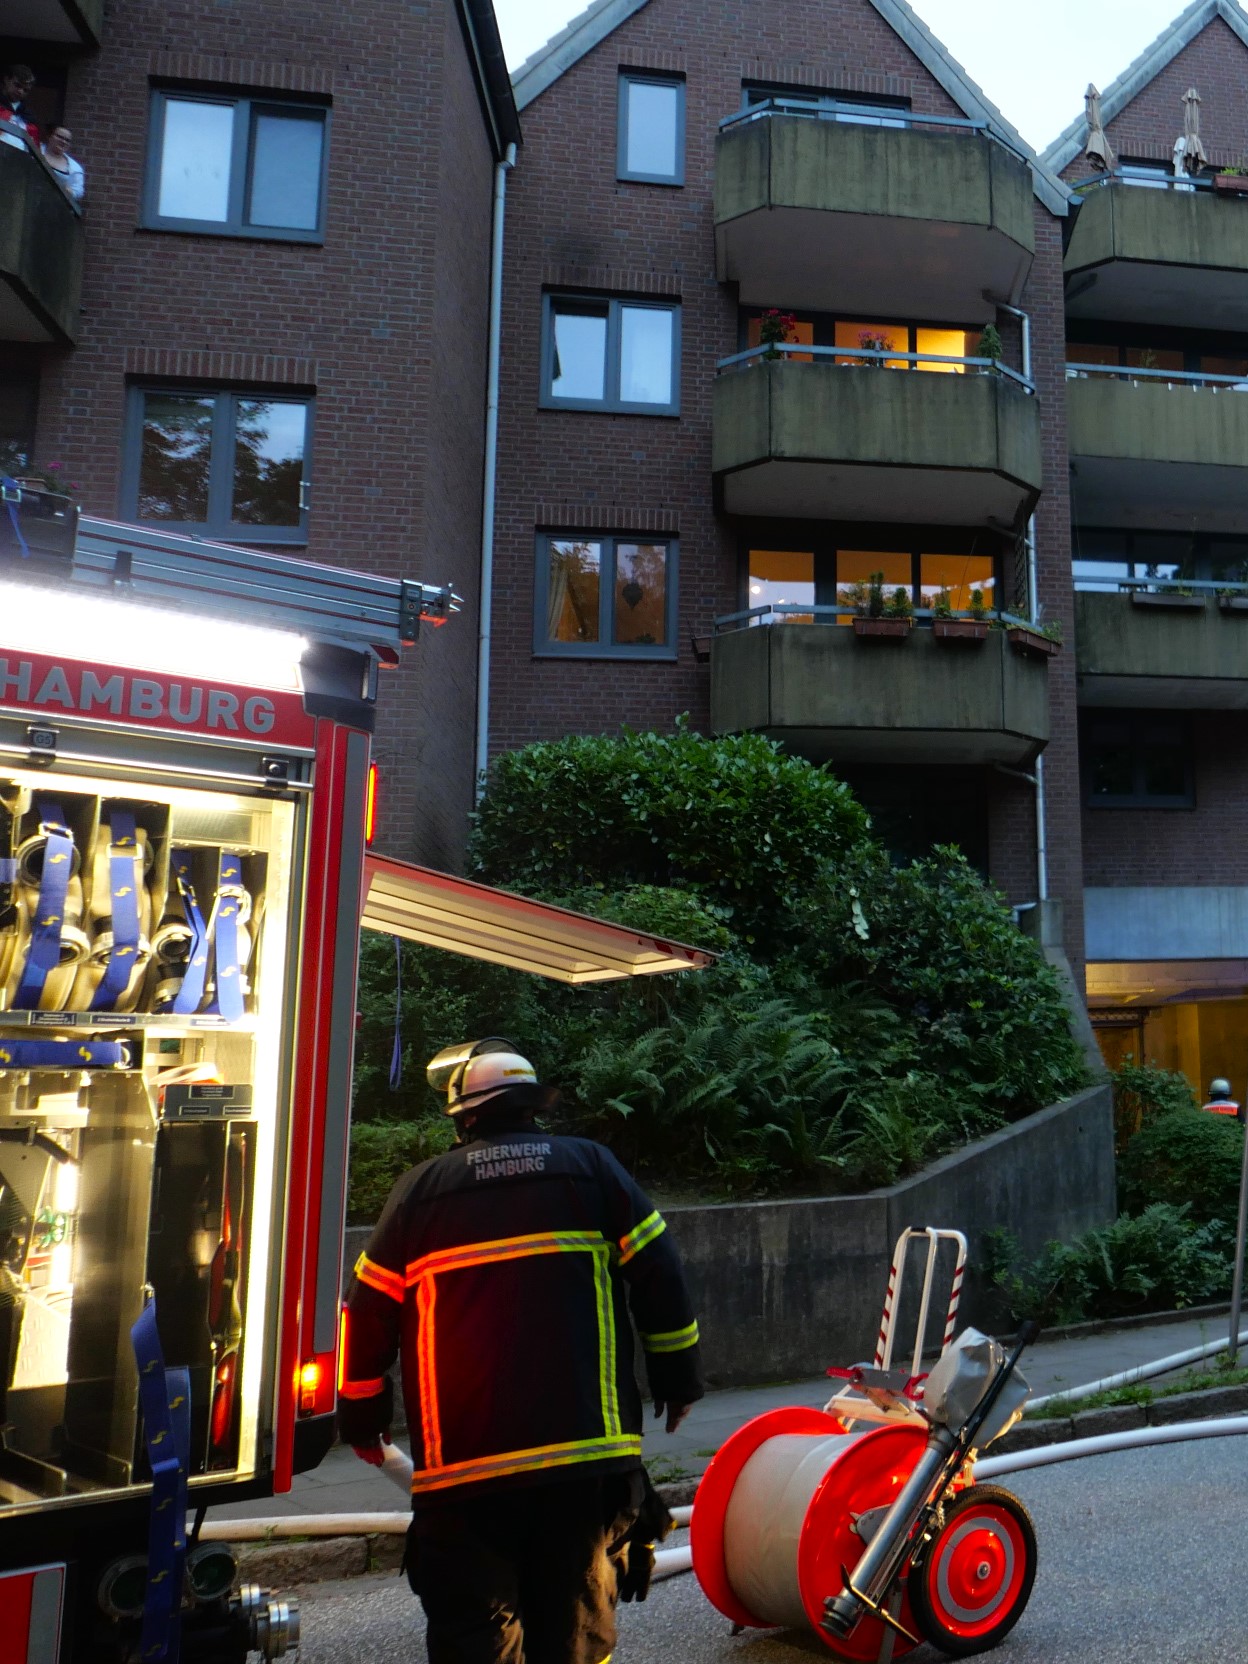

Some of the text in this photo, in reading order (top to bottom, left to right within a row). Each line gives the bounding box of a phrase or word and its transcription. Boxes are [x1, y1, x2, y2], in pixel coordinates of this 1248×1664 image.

[0, 658, 275, 734] HAMBURG
[466, 1142, 551, 1166] FEUERWEHR
[475, 1156, 545, 1180] HAMBURG
